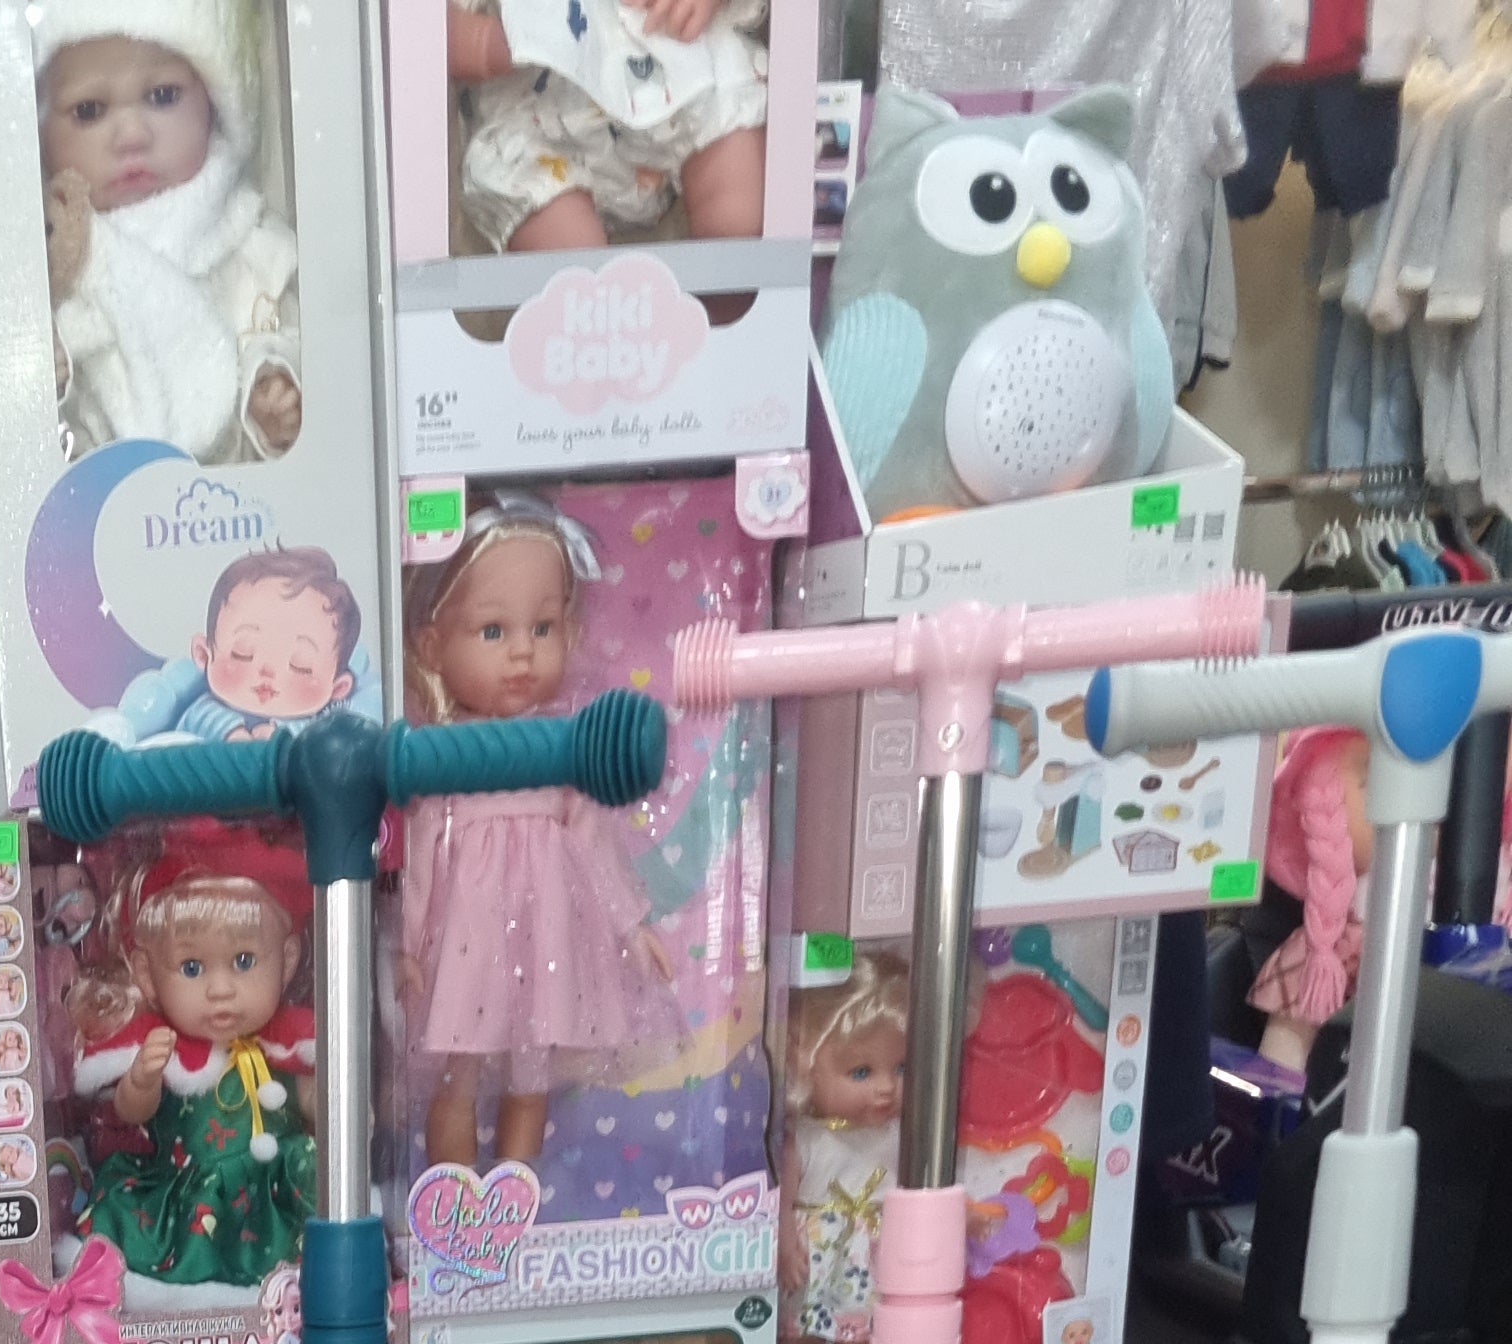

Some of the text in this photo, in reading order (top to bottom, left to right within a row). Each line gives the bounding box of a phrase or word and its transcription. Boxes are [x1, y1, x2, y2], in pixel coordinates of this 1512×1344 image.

[544, 334, 670, 393] Baby
[144, 512, 263, 550] Dream
[521, 1228, 774, 1288] FASHION Girl
